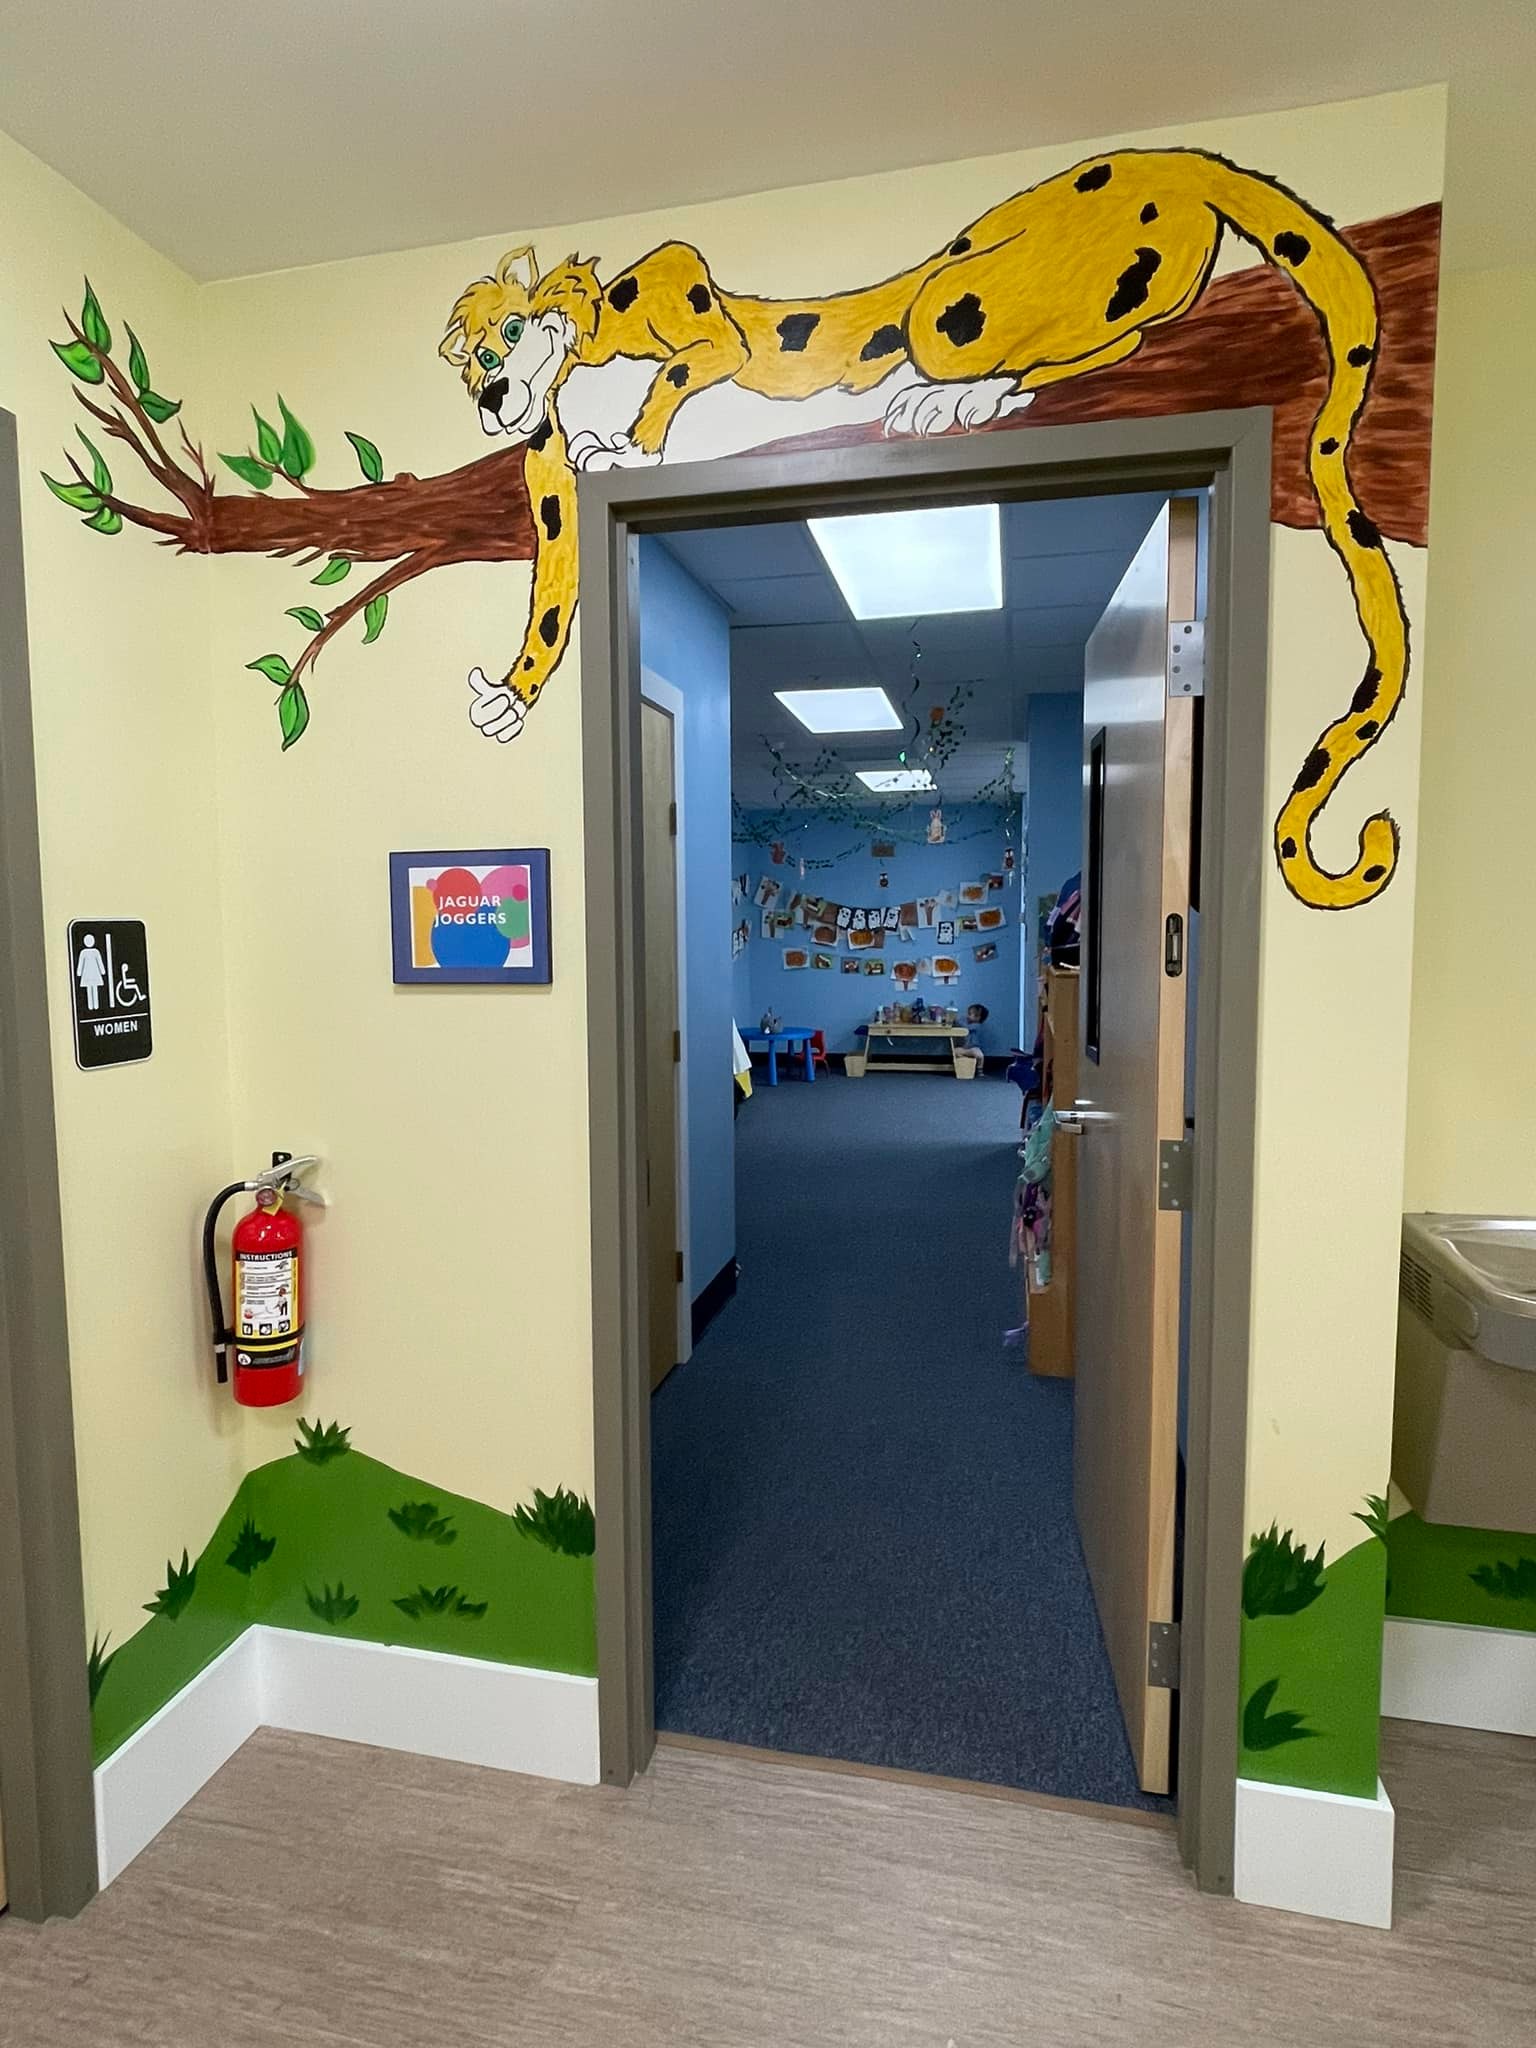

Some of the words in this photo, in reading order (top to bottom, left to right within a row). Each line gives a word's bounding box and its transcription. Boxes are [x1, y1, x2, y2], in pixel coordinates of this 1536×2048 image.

[439, 896, 501, 909] JAGUAR
[434, 913, 506, 927] JOGGERS
[94, 1020, 137, 1036] WOMEN
[240, 1251, 292, 1260] INSTRUCTIONS
